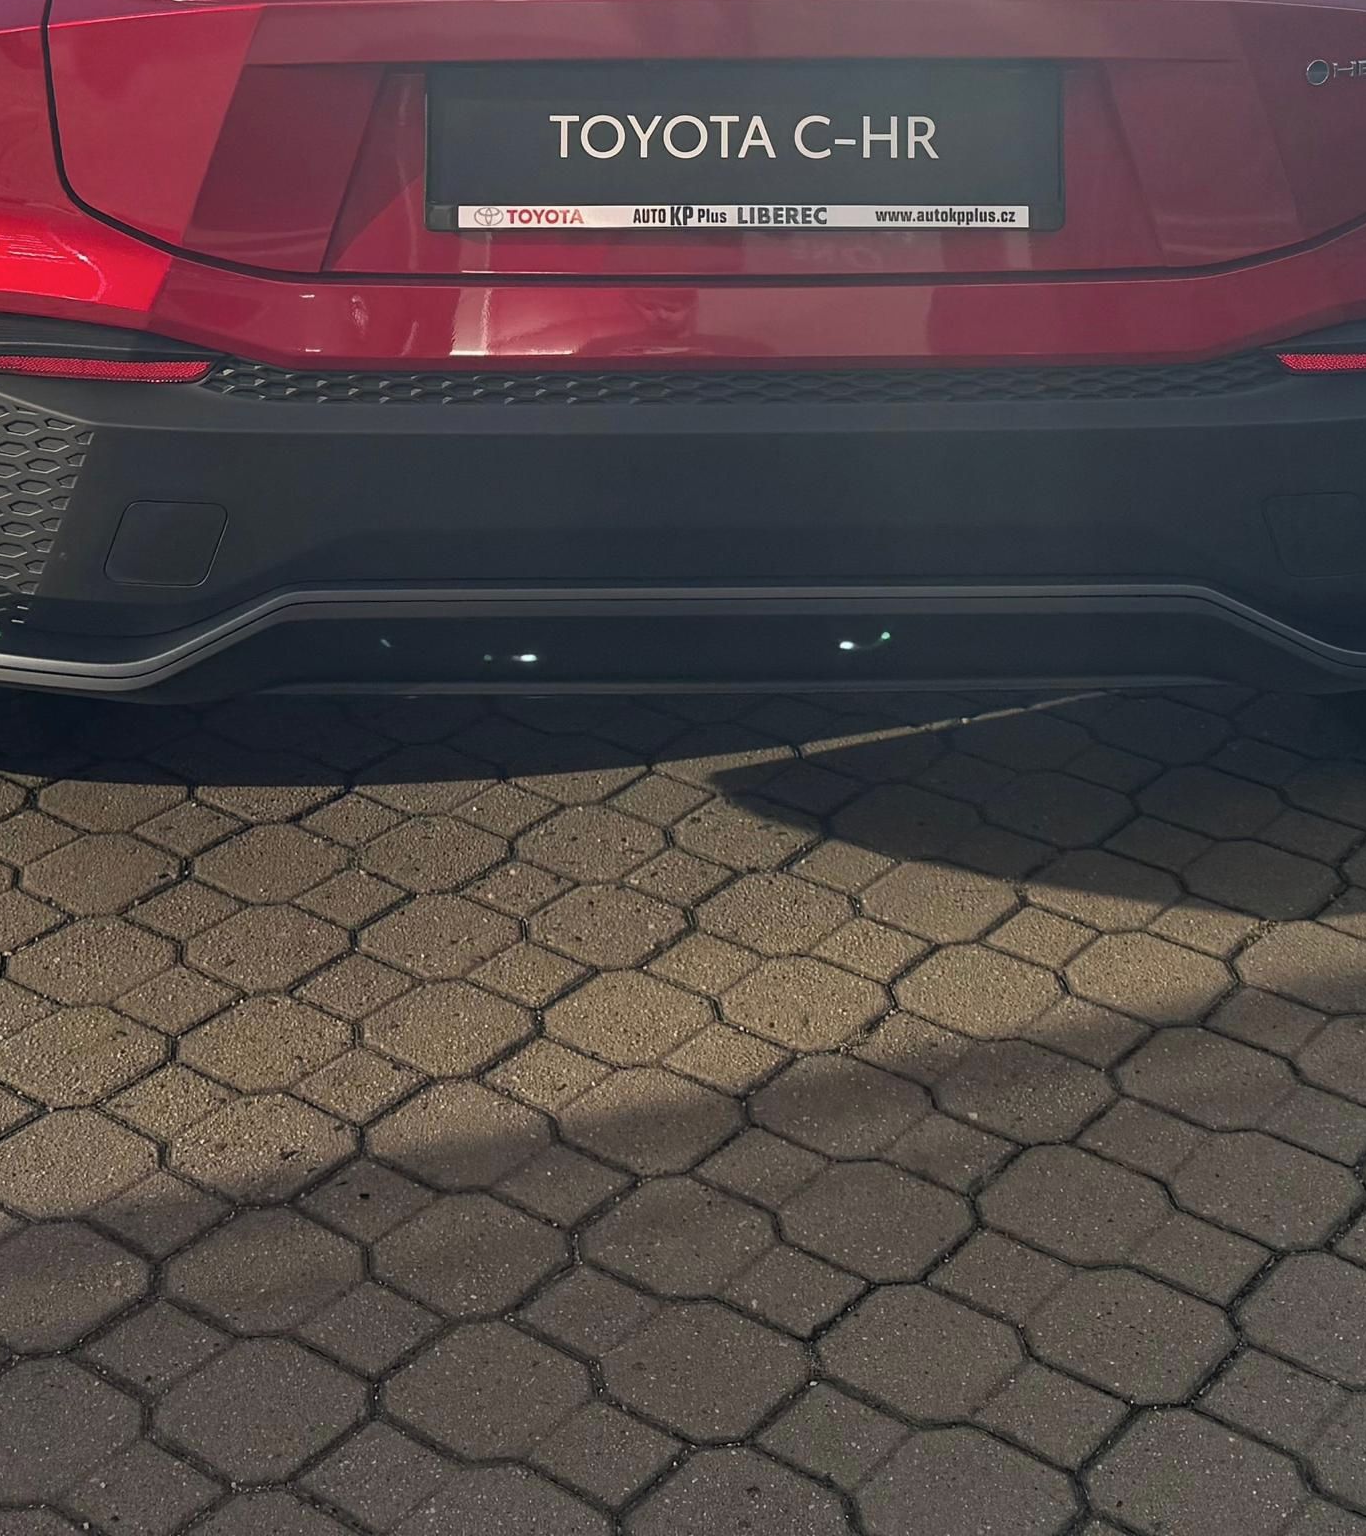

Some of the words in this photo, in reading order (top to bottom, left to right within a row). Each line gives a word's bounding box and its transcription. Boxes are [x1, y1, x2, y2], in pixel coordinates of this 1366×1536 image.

[549, 115, 776, 159] TOYOTA
[794, 115, 940, 160] C-HR
[506, 209, 584, 224] TOYOTA
[633, 208, 666, 224] AUTO
[670, 206, 694, 226] KP
[697, 208, 727, 224] Plus
[737, 207, 827, 225] LIBEREC
[875, 208, 1016, 225] www.autokpplus.cz
